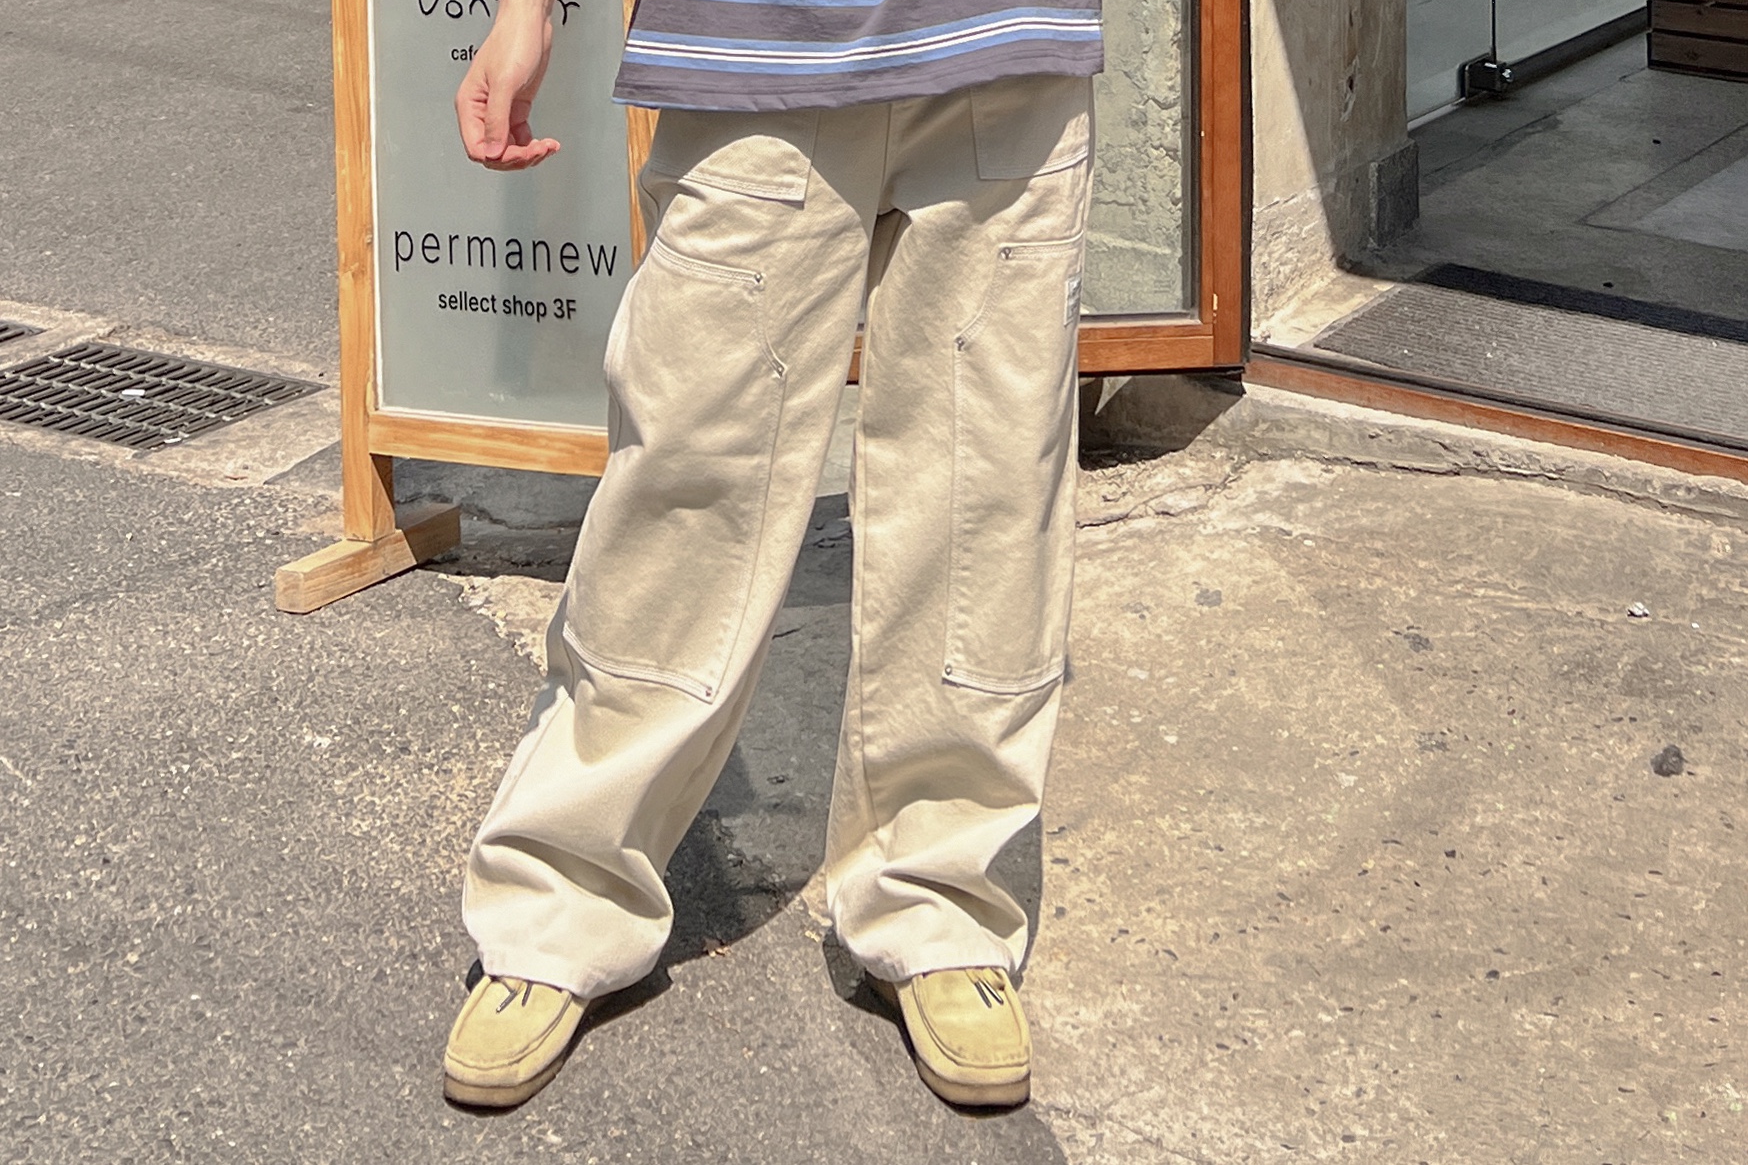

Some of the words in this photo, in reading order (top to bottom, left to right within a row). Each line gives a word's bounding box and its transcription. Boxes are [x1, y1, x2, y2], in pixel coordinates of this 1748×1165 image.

[394, 230, 618, 277] permanew
[438, 290, 498, 314] sellect
[502, 295, 548, 323] shop
[553, 298, 577, 320] 3F
